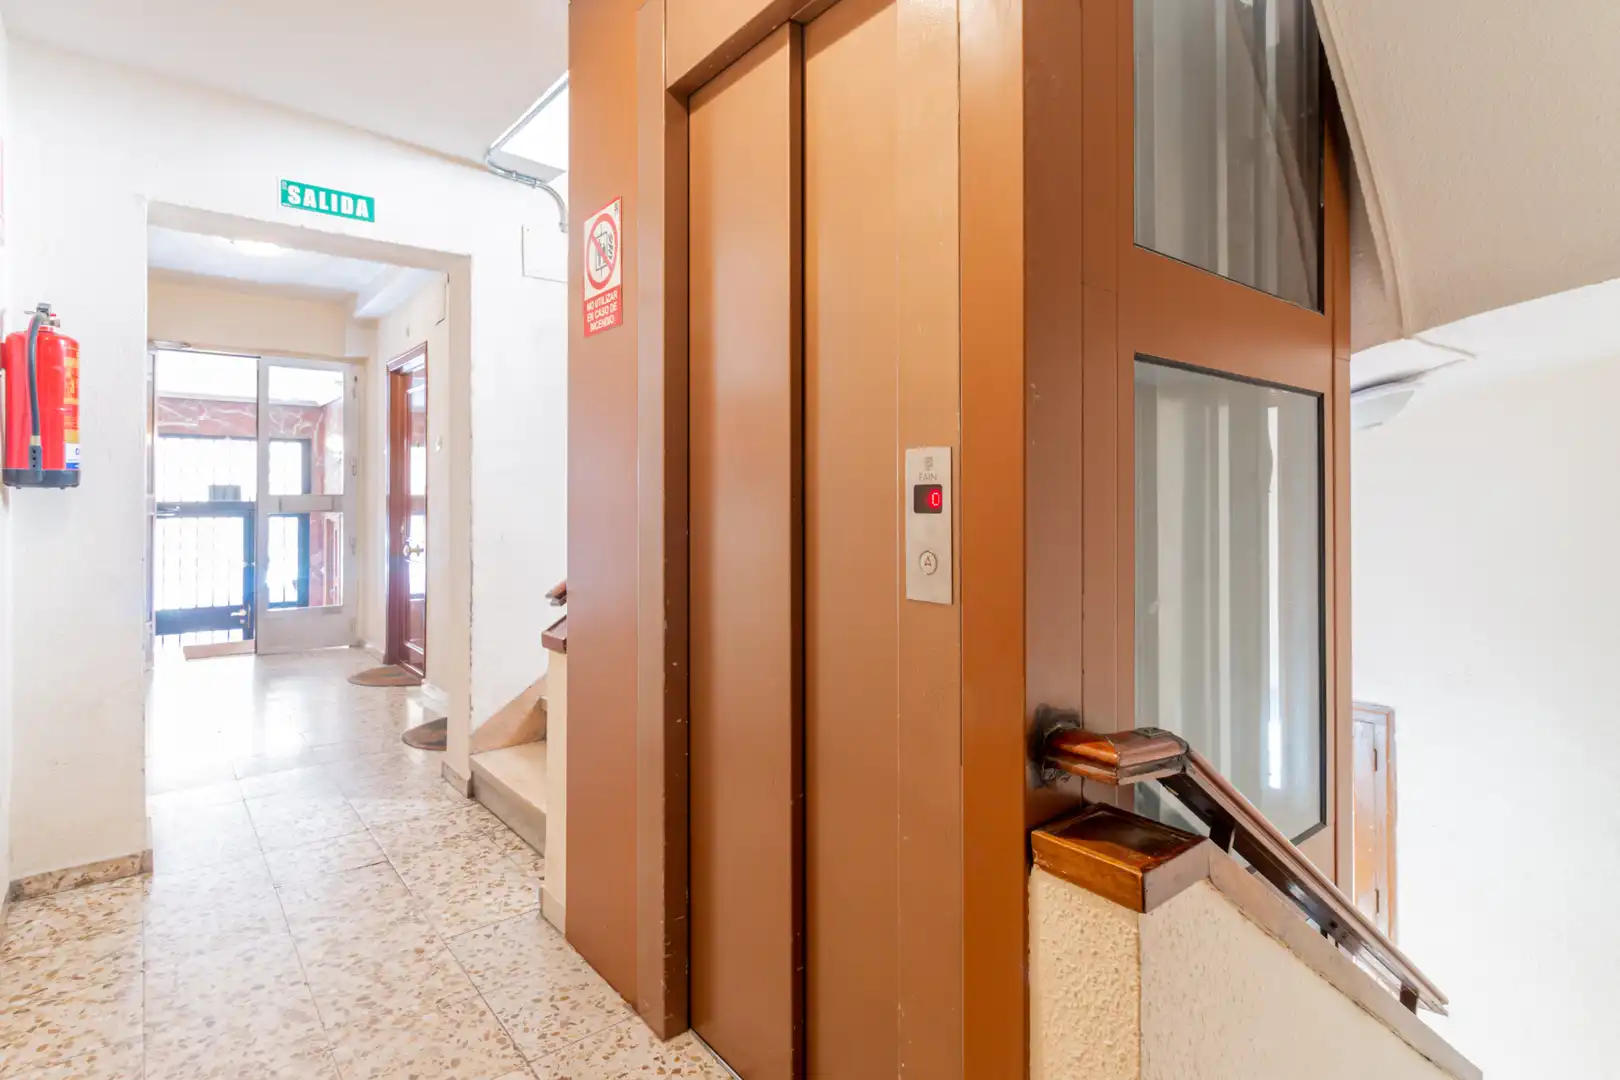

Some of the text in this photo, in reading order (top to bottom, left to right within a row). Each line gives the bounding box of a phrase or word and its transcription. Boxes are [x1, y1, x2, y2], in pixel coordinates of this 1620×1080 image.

[287, 184, 370, 218] SALIDA
[586, 290, 618, 312] NO UTILIZAR
[587, 301, 618, 323] EN CASO DE
[590, 314, 615, 333] INCENDIO
[931, 492, 940, 506] 0
